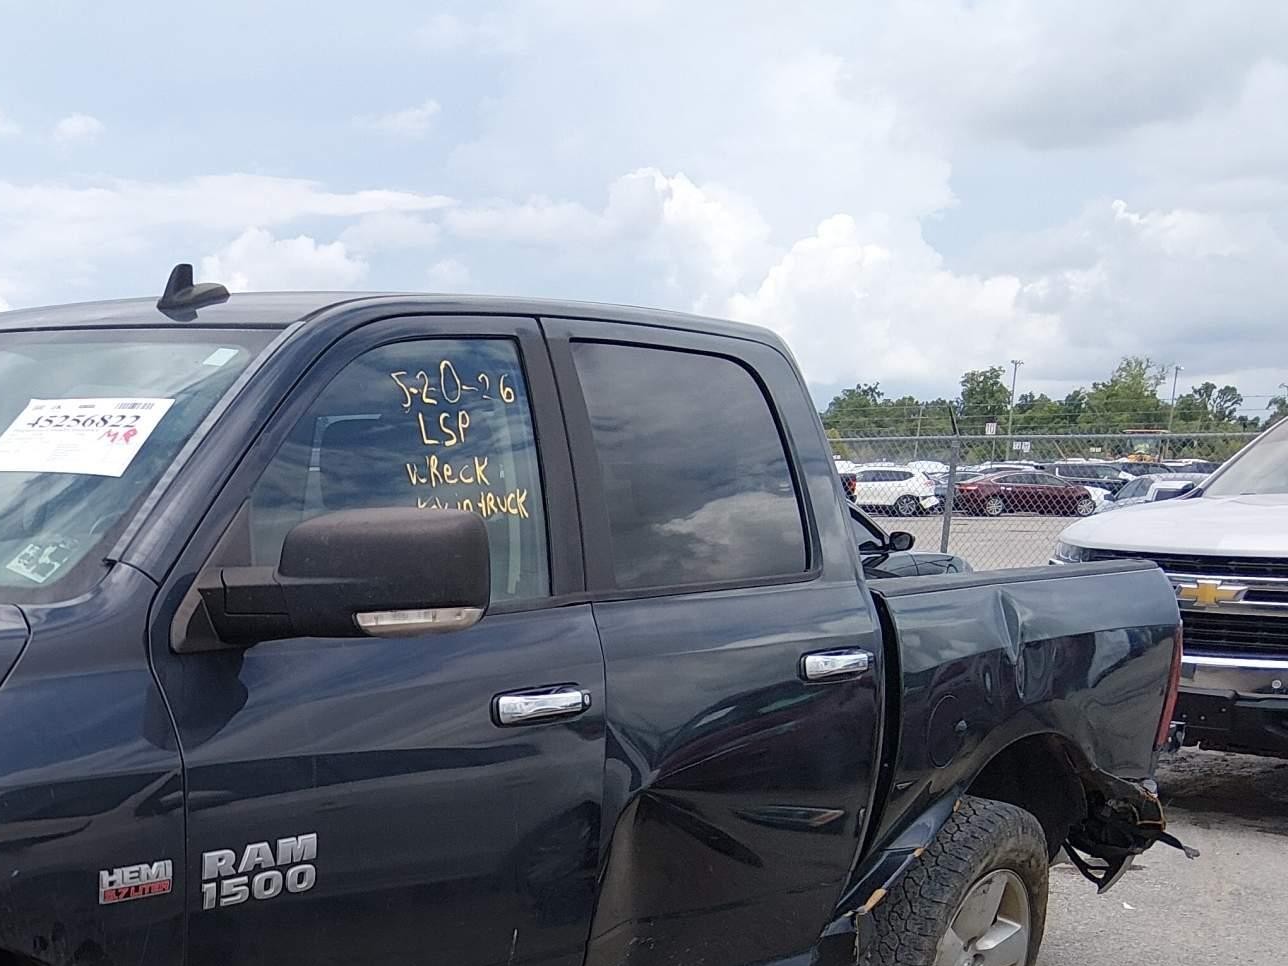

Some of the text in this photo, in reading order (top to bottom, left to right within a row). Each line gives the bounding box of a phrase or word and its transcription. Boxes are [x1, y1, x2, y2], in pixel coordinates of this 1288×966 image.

[27, 414, 142, 428] 45256822
[418, 410, 470, 446] LSP
[99, 860, 172, 889] HEMI
[202, 833, 317, 880] RAM
[202, 864, 316, 910] 1500
